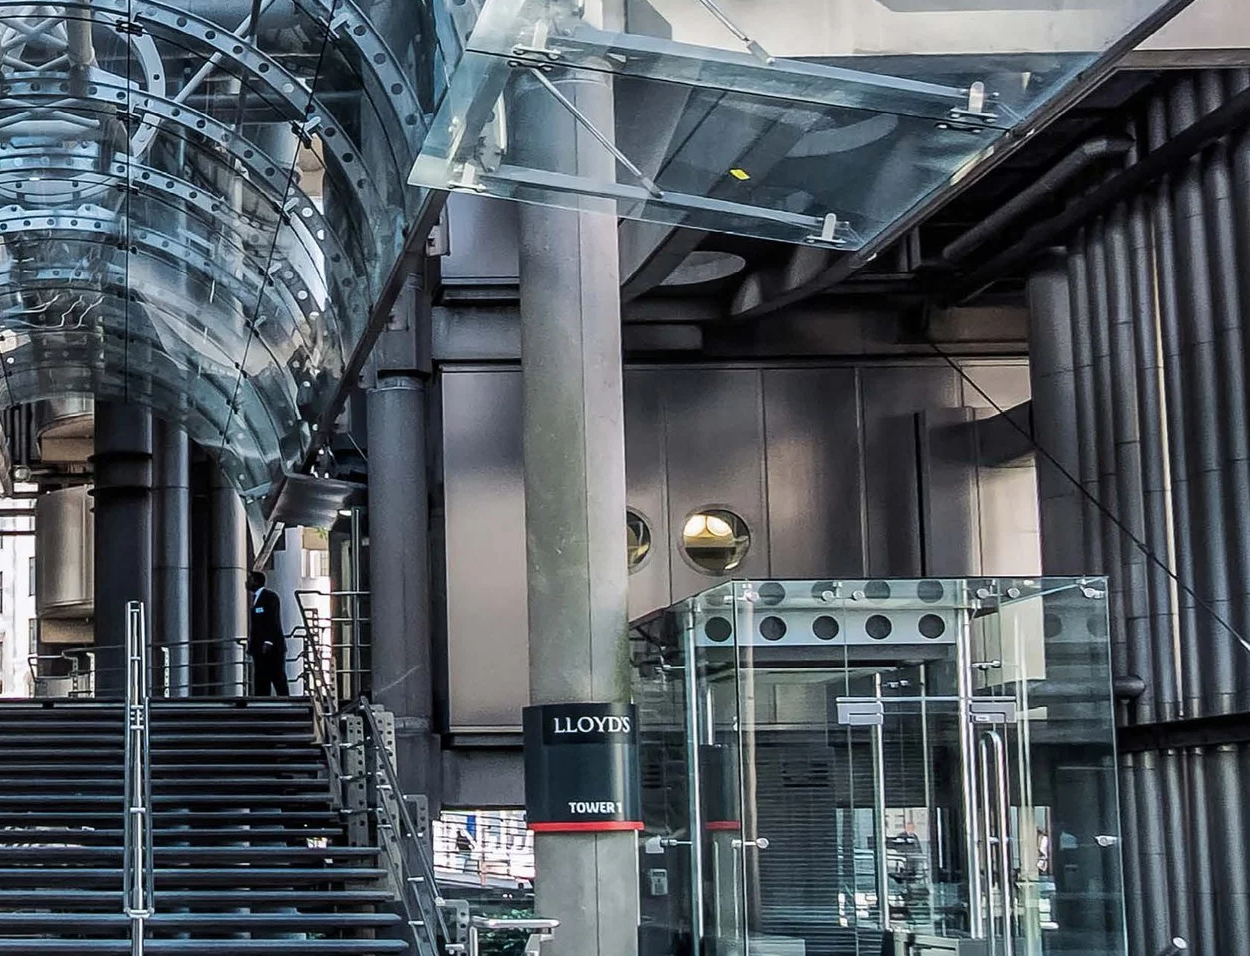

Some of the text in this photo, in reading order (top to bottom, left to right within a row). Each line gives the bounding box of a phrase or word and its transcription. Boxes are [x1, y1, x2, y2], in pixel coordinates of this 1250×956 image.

[553, 716, 631, 734] LLOYD'S
[568, 801, 623, 814] TOWER 1
